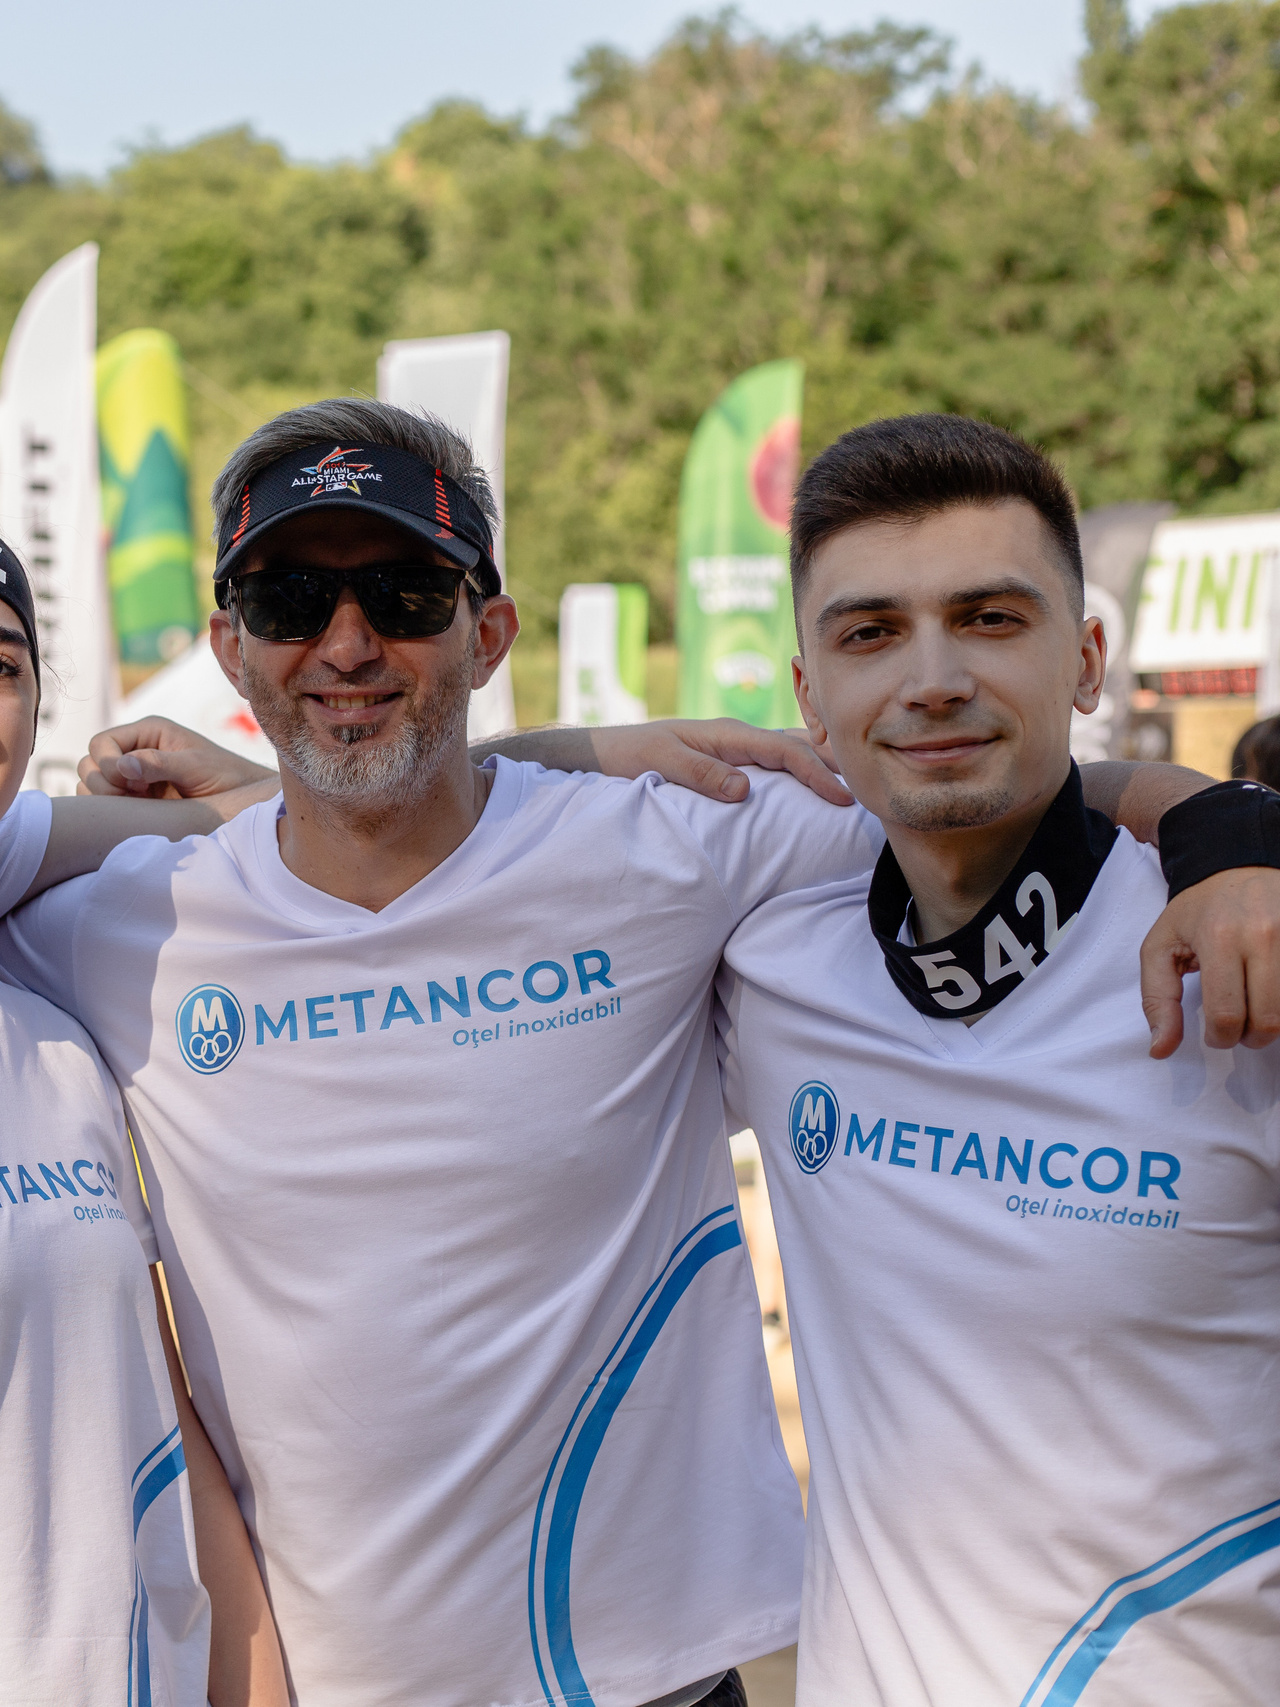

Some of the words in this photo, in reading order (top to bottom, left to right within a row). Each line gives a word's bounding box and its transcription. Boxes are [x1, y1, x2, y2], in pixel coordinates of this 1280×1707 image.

[323, 467, 350, 476] MIAMI
[346, 472, 383, 482] GAME
[910, 871, 1080, 1010] 542
[255, 949, 617, 1046] METANCOR
[508, 996, 622, 1037] inoxidabil
[843, 1112, 1181, 1201] METANCOR
[1052, 1198, 1180, 1230] inoxidabil
